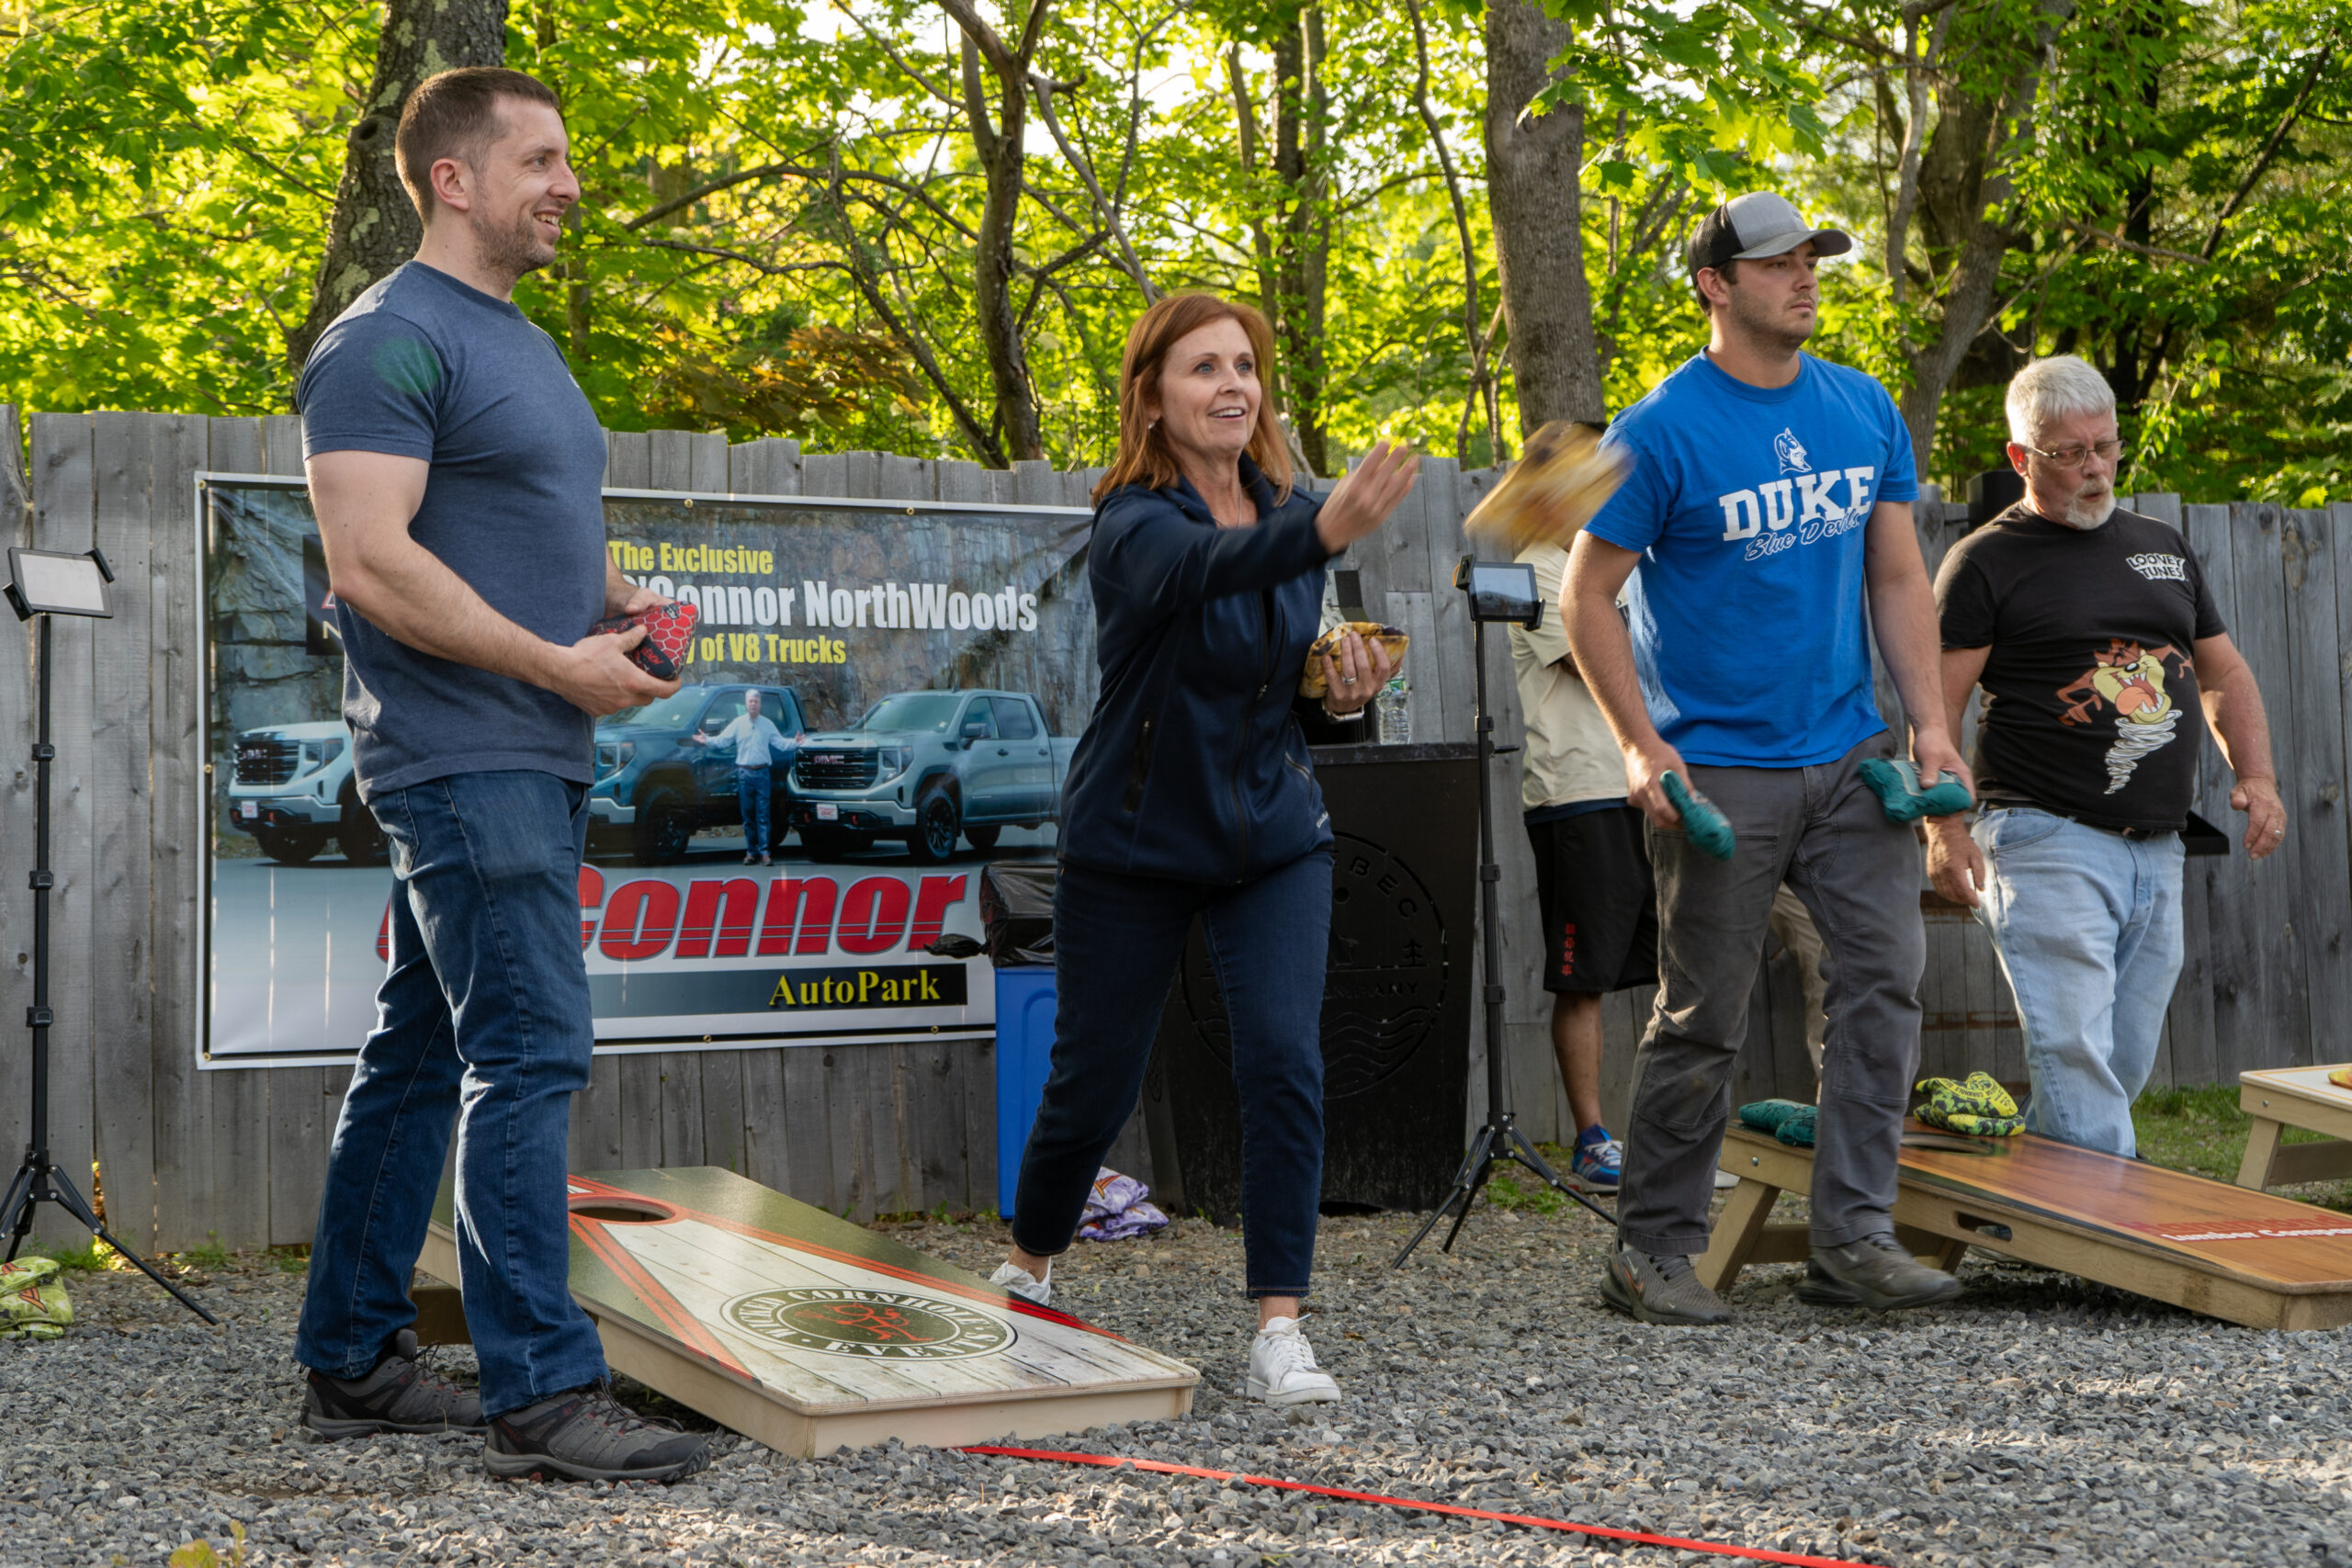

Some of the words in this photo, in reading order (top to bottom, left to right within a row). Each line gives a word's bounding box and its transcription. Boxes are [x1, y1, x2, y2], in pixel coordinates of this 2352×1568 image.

[1718, 466, 1874, 542] DUKE
[1744, 531, 1797, 561] Blue
[1799, 508, 1860, 546] Devils
[608, 540, 655, 570] The
[660, 542, 774, 575] Exclusive
[2126, 553, 2186, 571] LOONEY
[2139, 566, 2186, 581] TUNES
[622, 575, 796, 626] 'onnor
[803, 581, 1037, 632] NorthWoods
[701, 633, 724, 662] of
[728, 633, 761, 663] V8
[764, 634, 846, 665] Trucks
[769, 967, 942, 1008] AutoPark
[2161, 1231, 2260, 1241] Lumber
[739, 1297, 793, 1338] WICKED
[786, 1290, 990, 1328] CORNHOLE
[824, 1331, 1001, 1358] EVENTS
